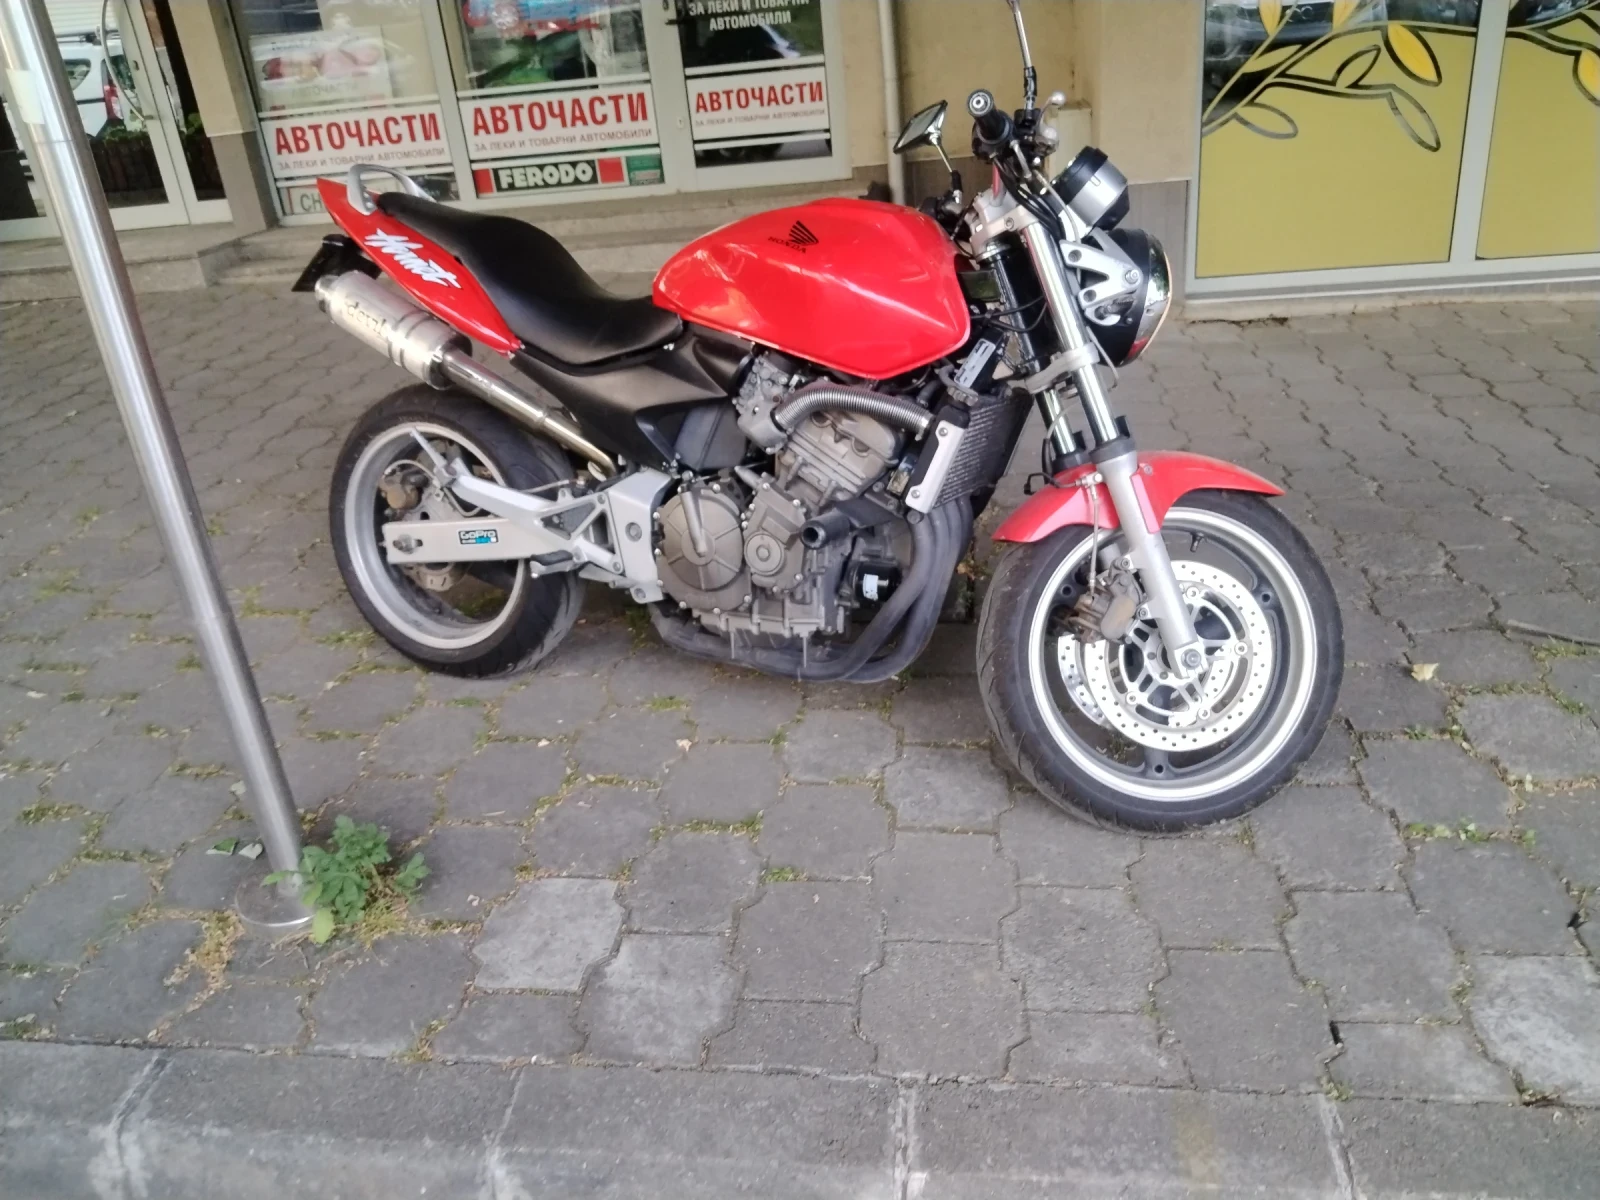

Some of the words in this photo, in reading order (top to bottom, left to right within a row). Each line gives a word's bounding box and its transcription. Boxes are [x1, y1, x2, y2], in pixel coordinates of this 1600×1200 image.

[689, 1, 705, 16] ЗА
[707, 0, 739, 14] ЛЕКИ
[709, 10, 792, 31] АВТОМОБИЛИ
[695, 81, 824, 114] АВТОЧАСТИ
[473, 92, 648, 136] АВТОЧАСТИ
[275, 112, 441, 155] АВТОЧАСТИ
[474, 143, 487, 152] ЗА
[489, 140, 516, 150] ЛЕКИ
[519, 139, 526, 148] И
[528, 134, 577, 148] ТОВАРНИ
[579, 127, 652, 143] АВТОМОБИЛИ
[278, 161, 290, 171] ЗА
[292, 158, 318, 169] ЛЕКИ
[320, 157, 327, 167] И
[330, 153, 375, 166] ТОВАРНИ
[377, 147, 446, 162] АВТОМОБИЛИ
[498, 162, 594, 189] FERODO
[460, 530, 496, 539] GoPro
